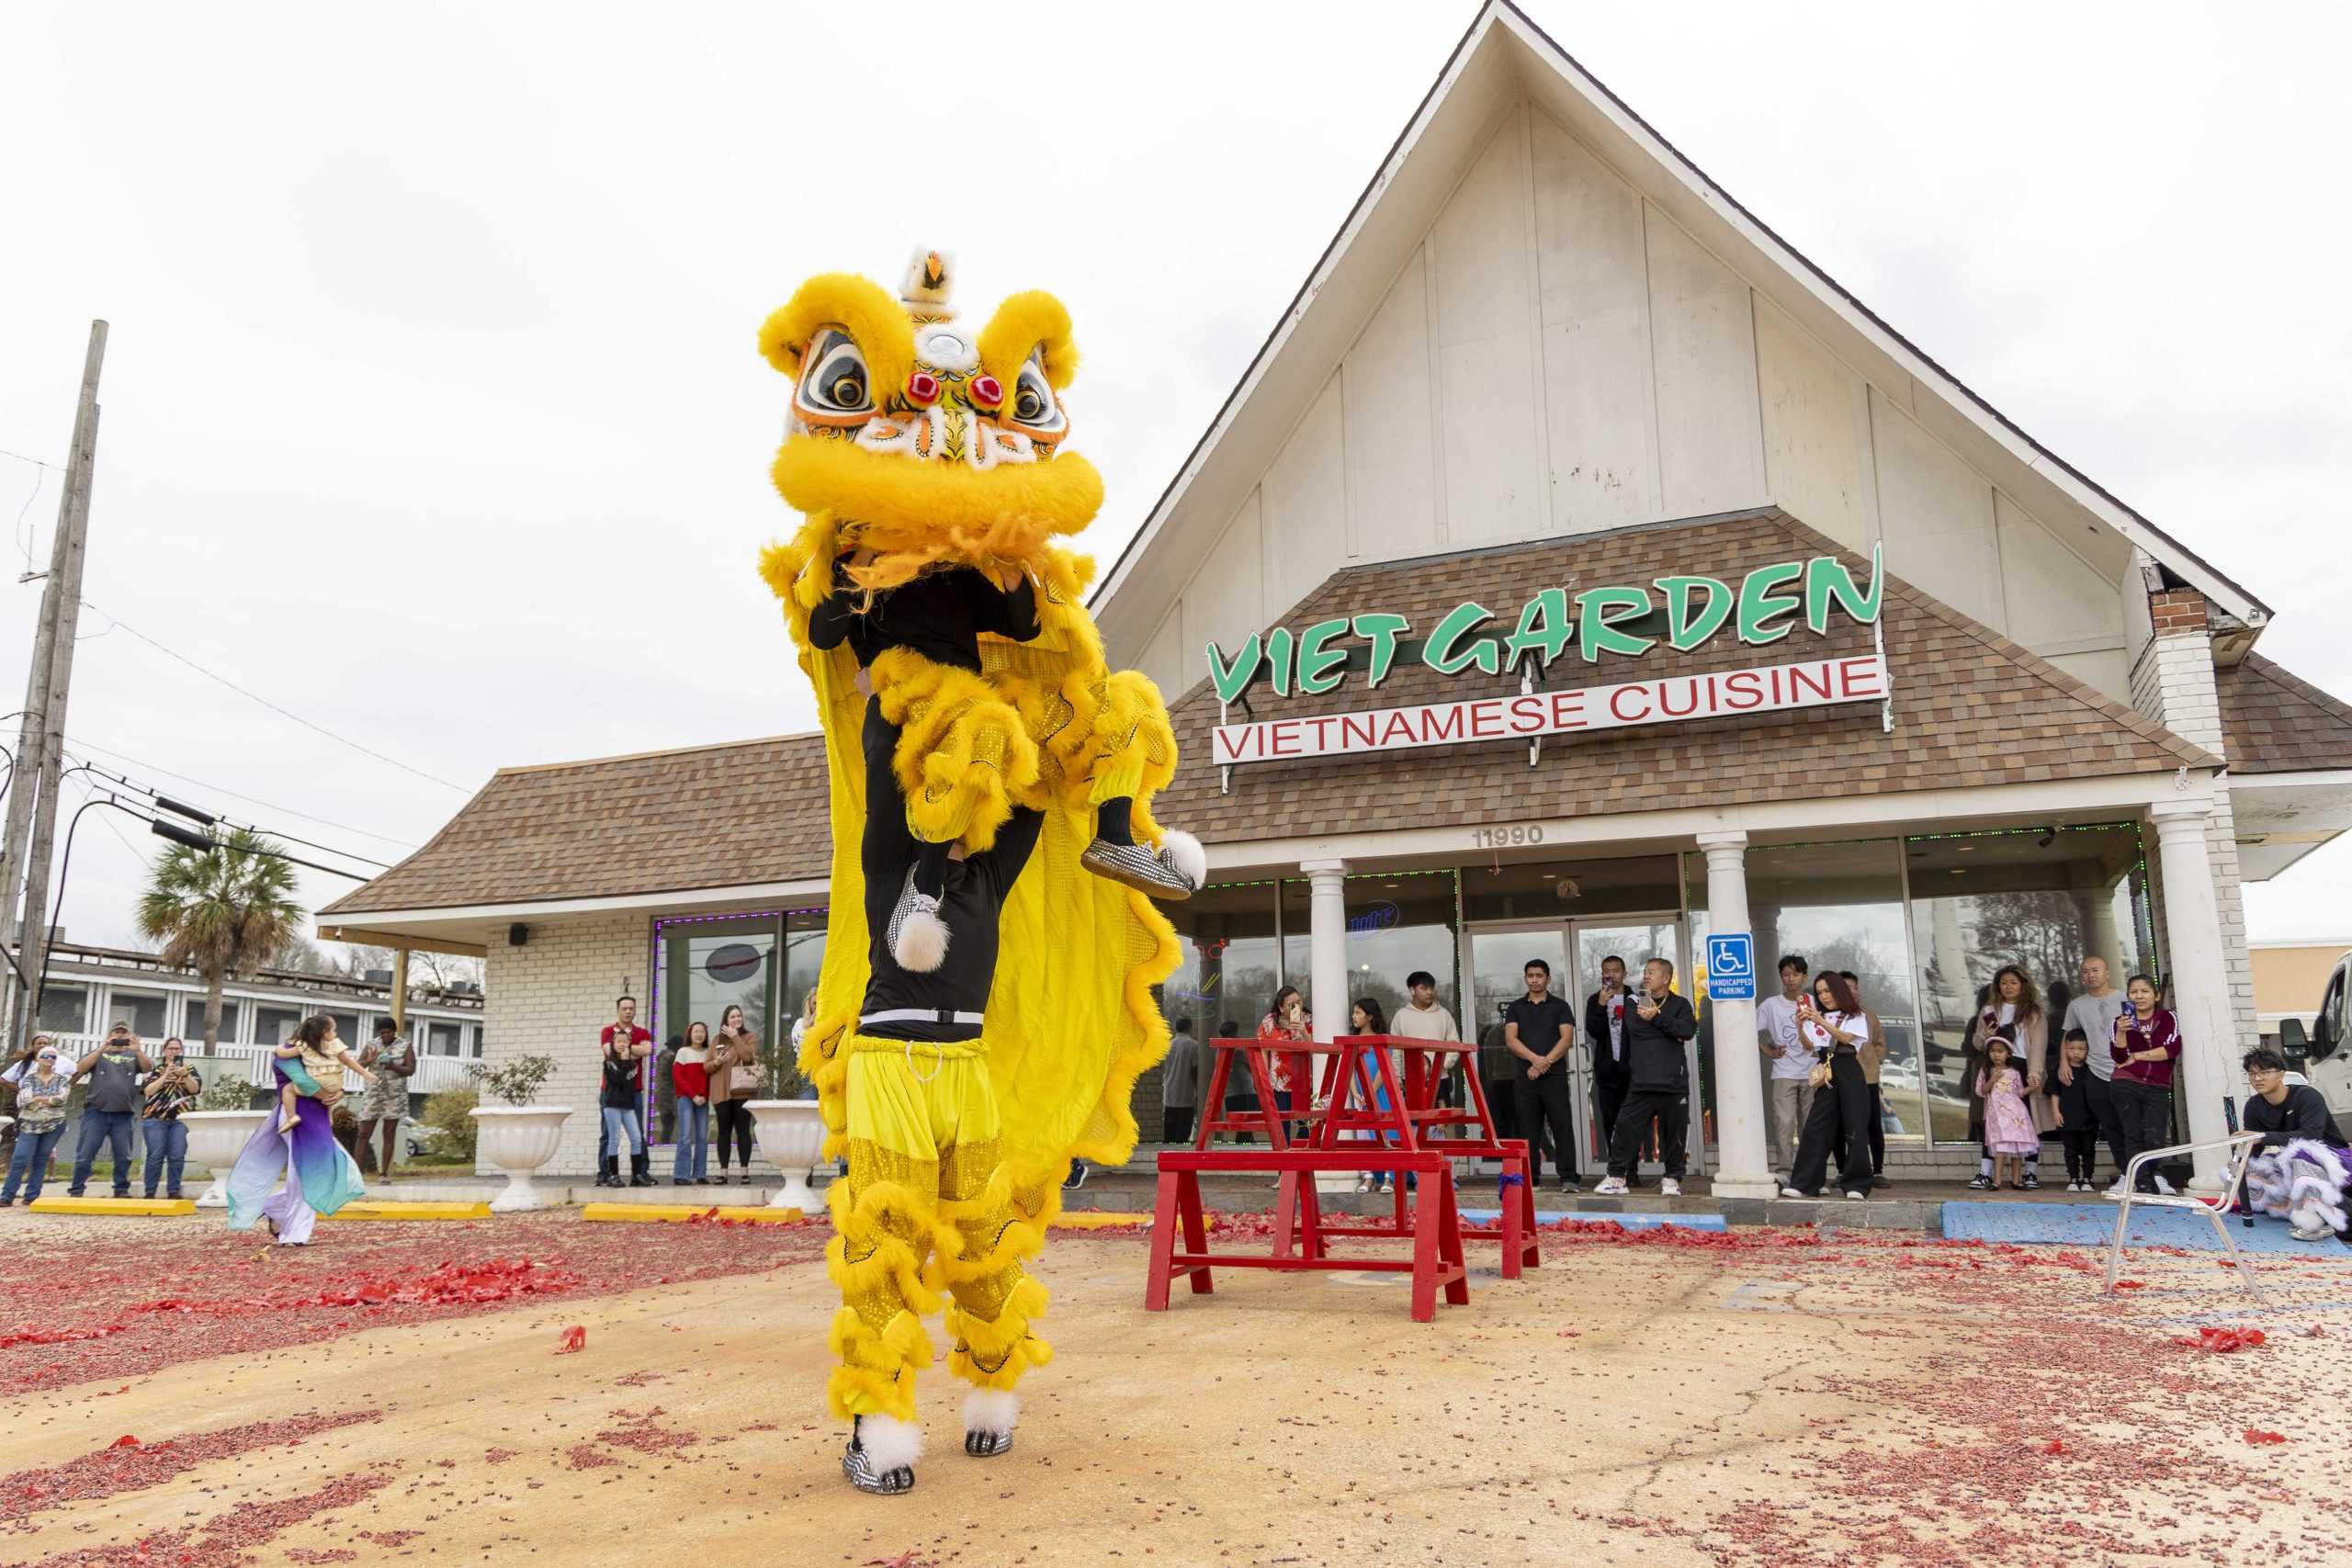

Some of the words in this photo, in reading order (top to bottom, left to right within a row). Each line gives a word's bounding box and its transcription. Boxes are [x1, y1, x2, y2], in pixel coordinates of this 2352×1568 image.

[1205, 614, 1409, 704] VIET
[1422, 540, 1882, 675] GARDEN
[1218, 691, 1588, 759] VIETNAMESE
[1610, 658, 1882, 721] CUISINE
[1472, 825, 1544, 847] 11990
[1710, 977, 1752, 987] HANDICAPPED
[1719, 987, 1746, 995] PARKING
